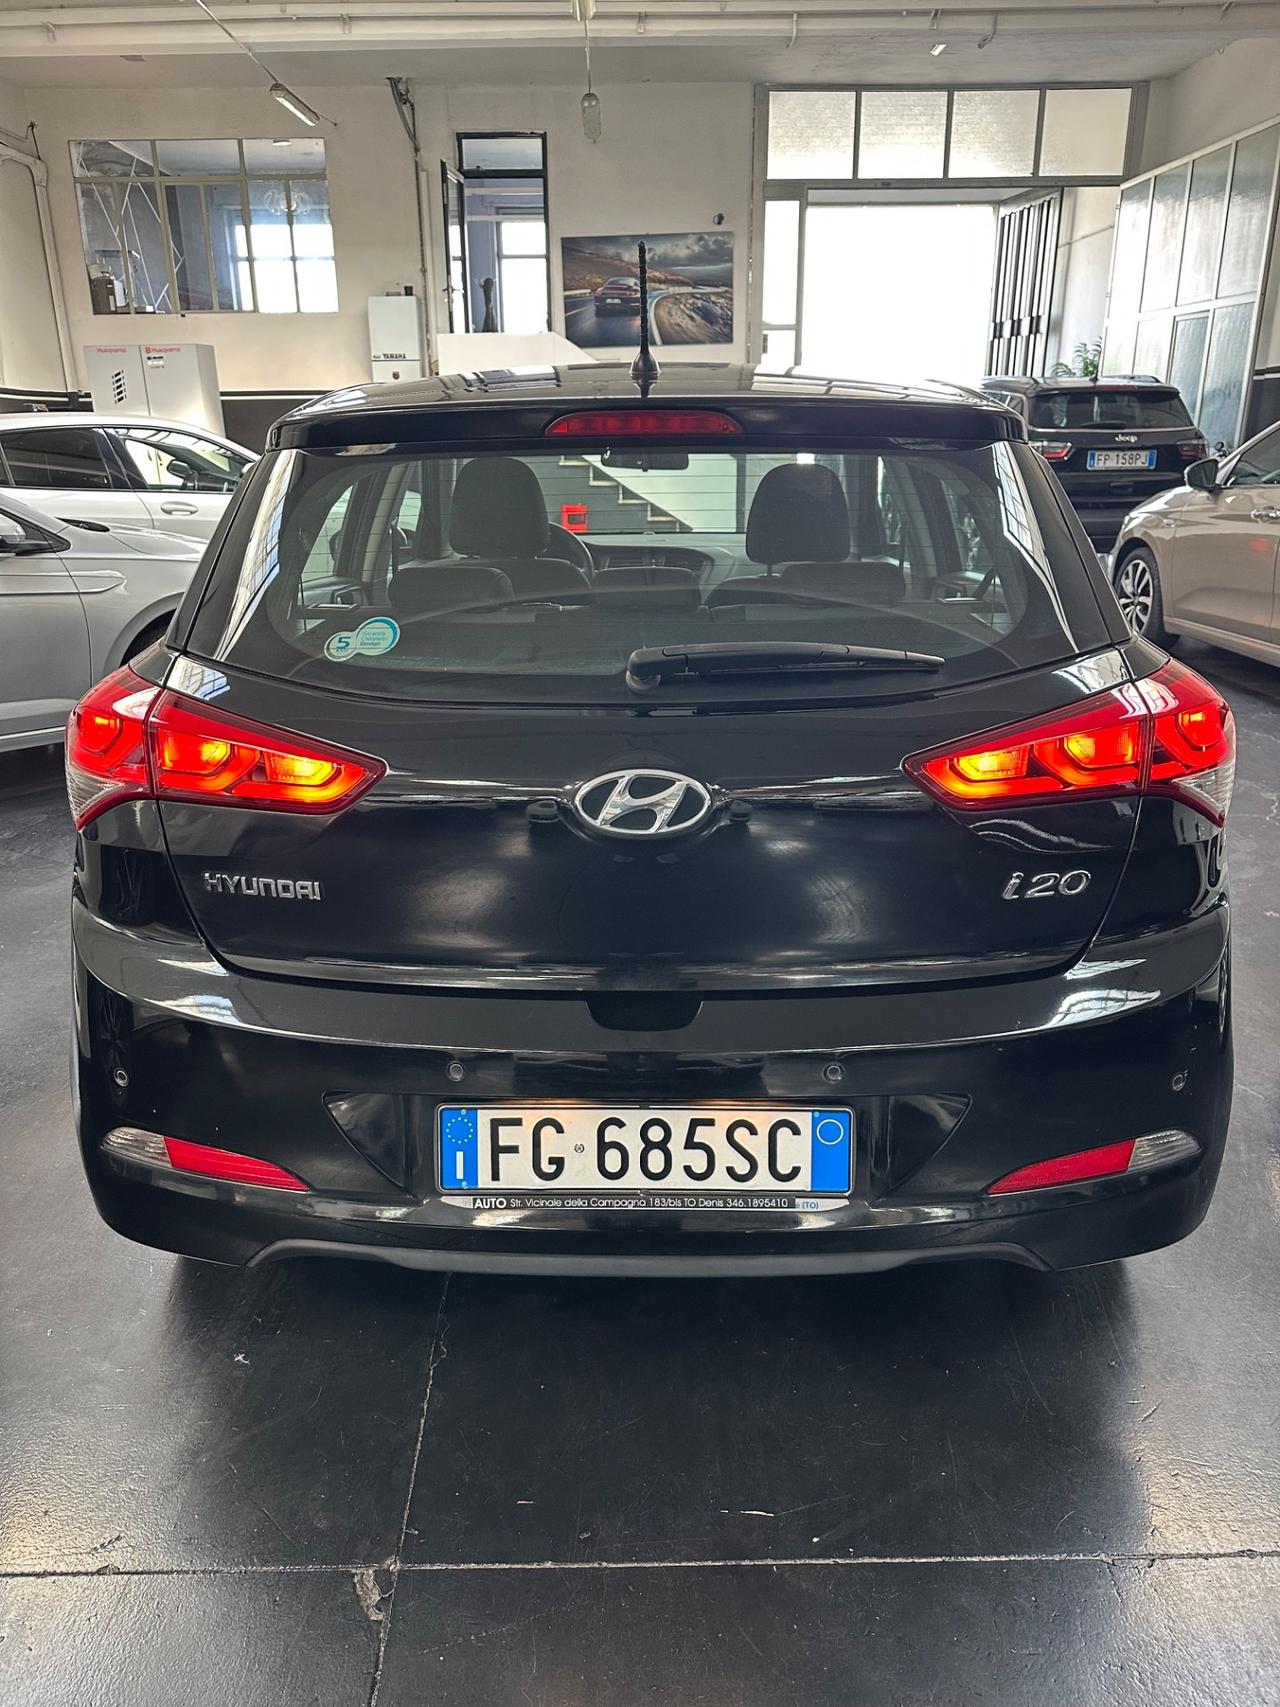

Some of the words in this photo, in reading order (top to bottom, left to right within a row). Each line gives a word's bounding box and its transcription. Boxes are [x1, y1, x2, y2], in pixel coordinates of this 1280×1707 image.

[1115, 434, 1138, 442] Jeep
[1096, 453, 1110, 466] FP
[1115, 453, 1149, 466] 158PJ
[337, 636, 352, 650] 5
[204, 872, 321, 900] HYUNDAI
[1002, 869, 1092, 900] i20
[489, 1117, 566, 1182] FG
[596, 1116, 802, 1183] 685SC
[474, 1198, 507, 1209] AUTO
[510, 1198, 523, 1208] Str.
[526, 1198, 562, 1208] Vicinale
[564, 1198, 588, 1208] della
[590, 1198, 647, 1210] Campagna
[649, 1198, 682, 1208] 183/bis
[684, 1198, 697, 1208] TO
[698, 1198, 724, 1208] Denis
[726, 1198, 789, 1208] 346.1895410
[801, 1201, 819, 1210] (TO)
